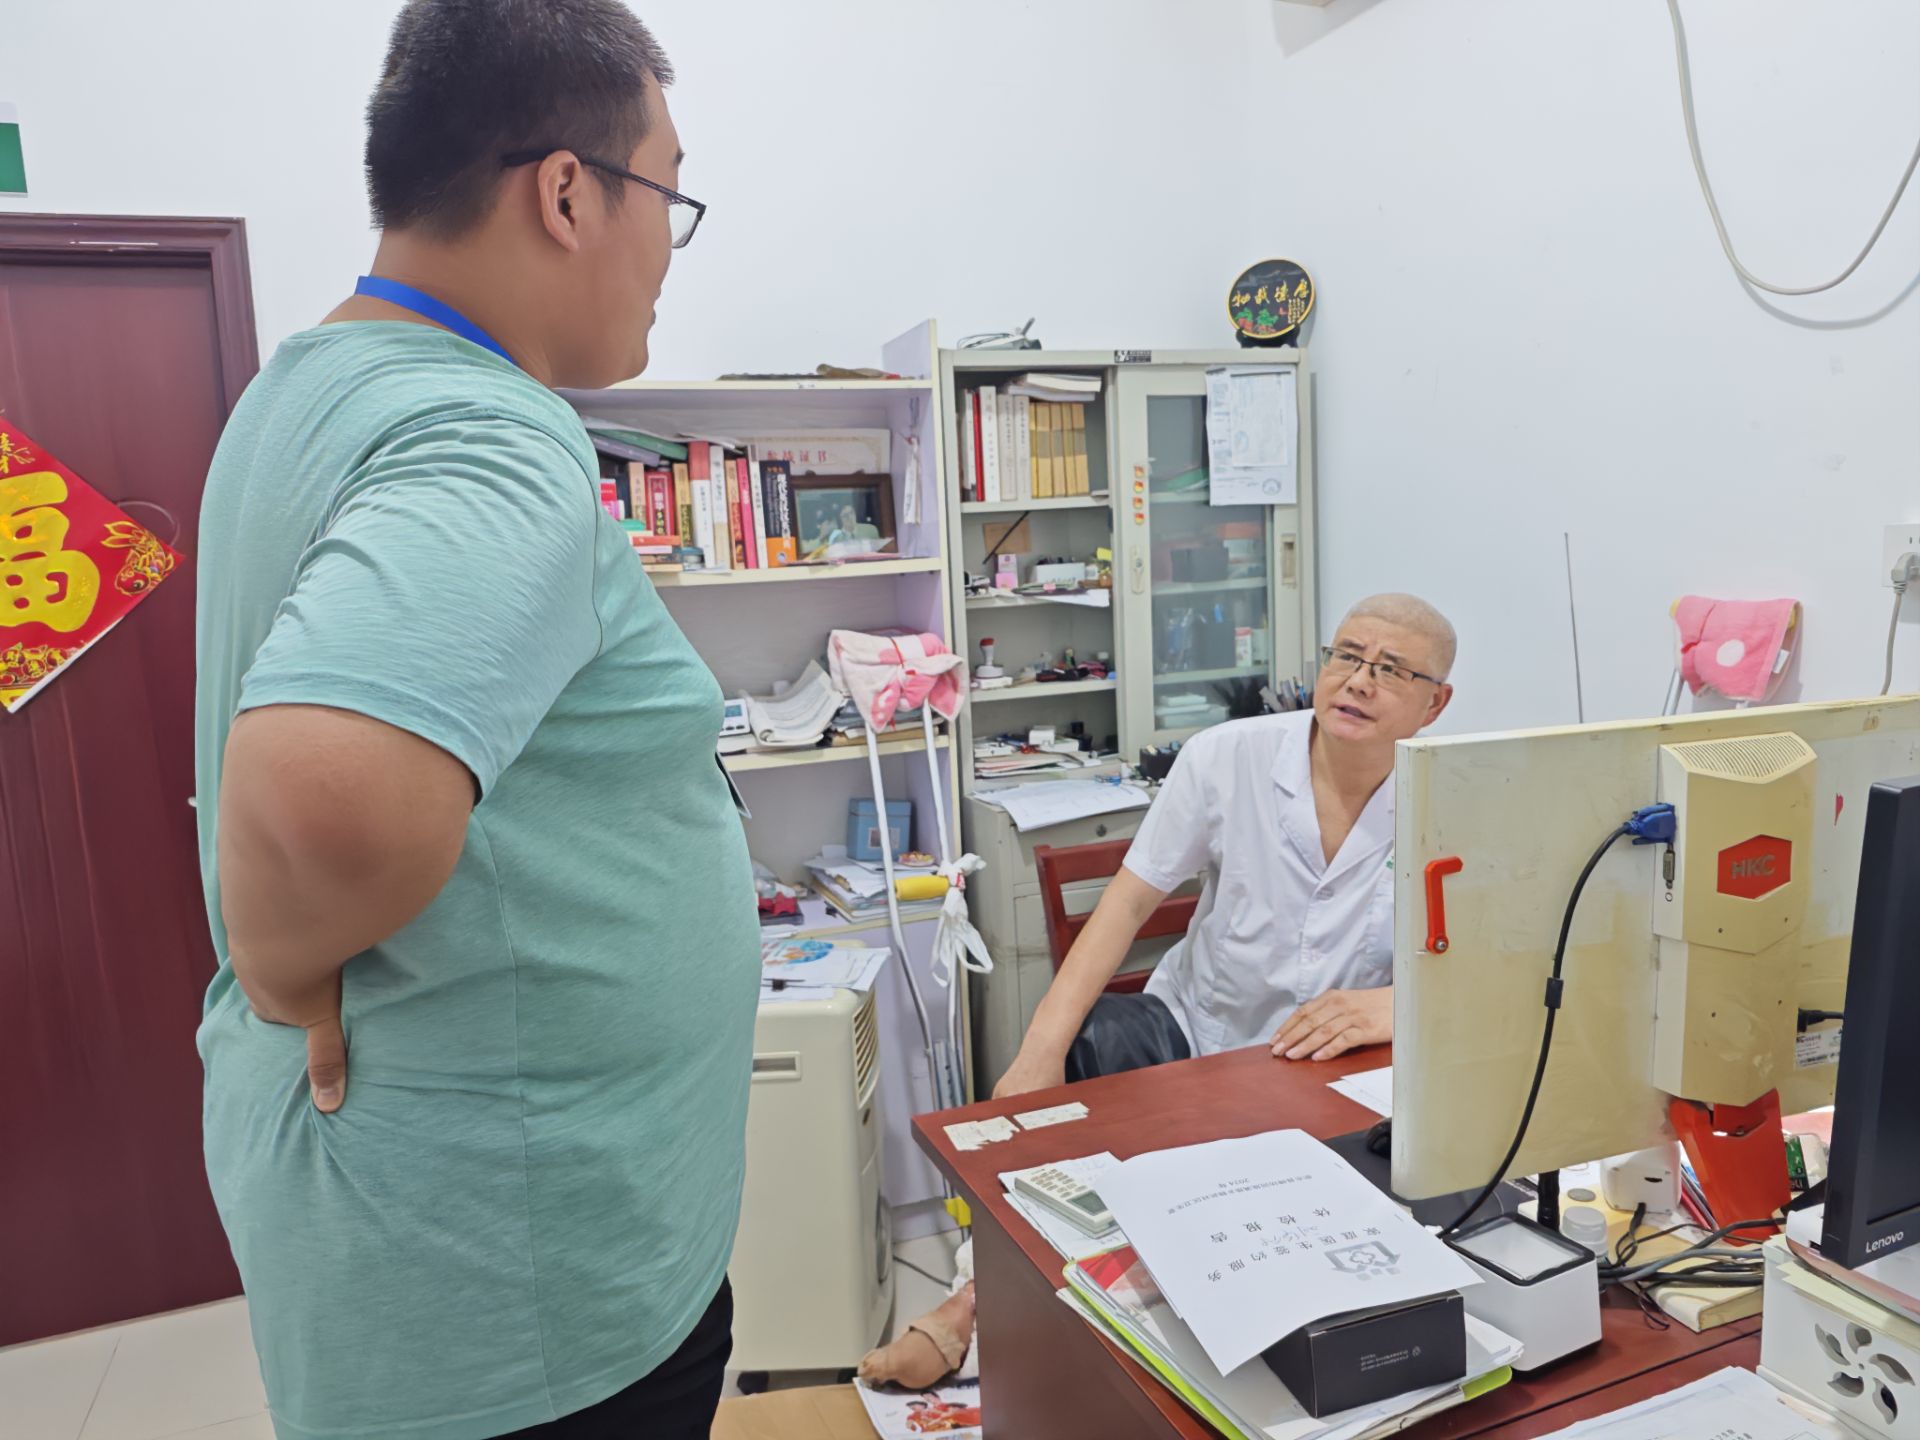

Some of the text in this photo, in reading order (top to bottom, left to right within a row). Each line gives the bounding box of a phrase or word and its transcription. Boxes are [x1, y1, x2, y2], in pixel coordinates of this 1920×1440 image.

[1732, 854, 1775, 879] HKC
[1210, 1207, 1331, 1244] 体检报告
[1207, 1227, 1381, 1283] 家庭医生签约服务
[1865, 1231, 1904, 1253] Lenovo
